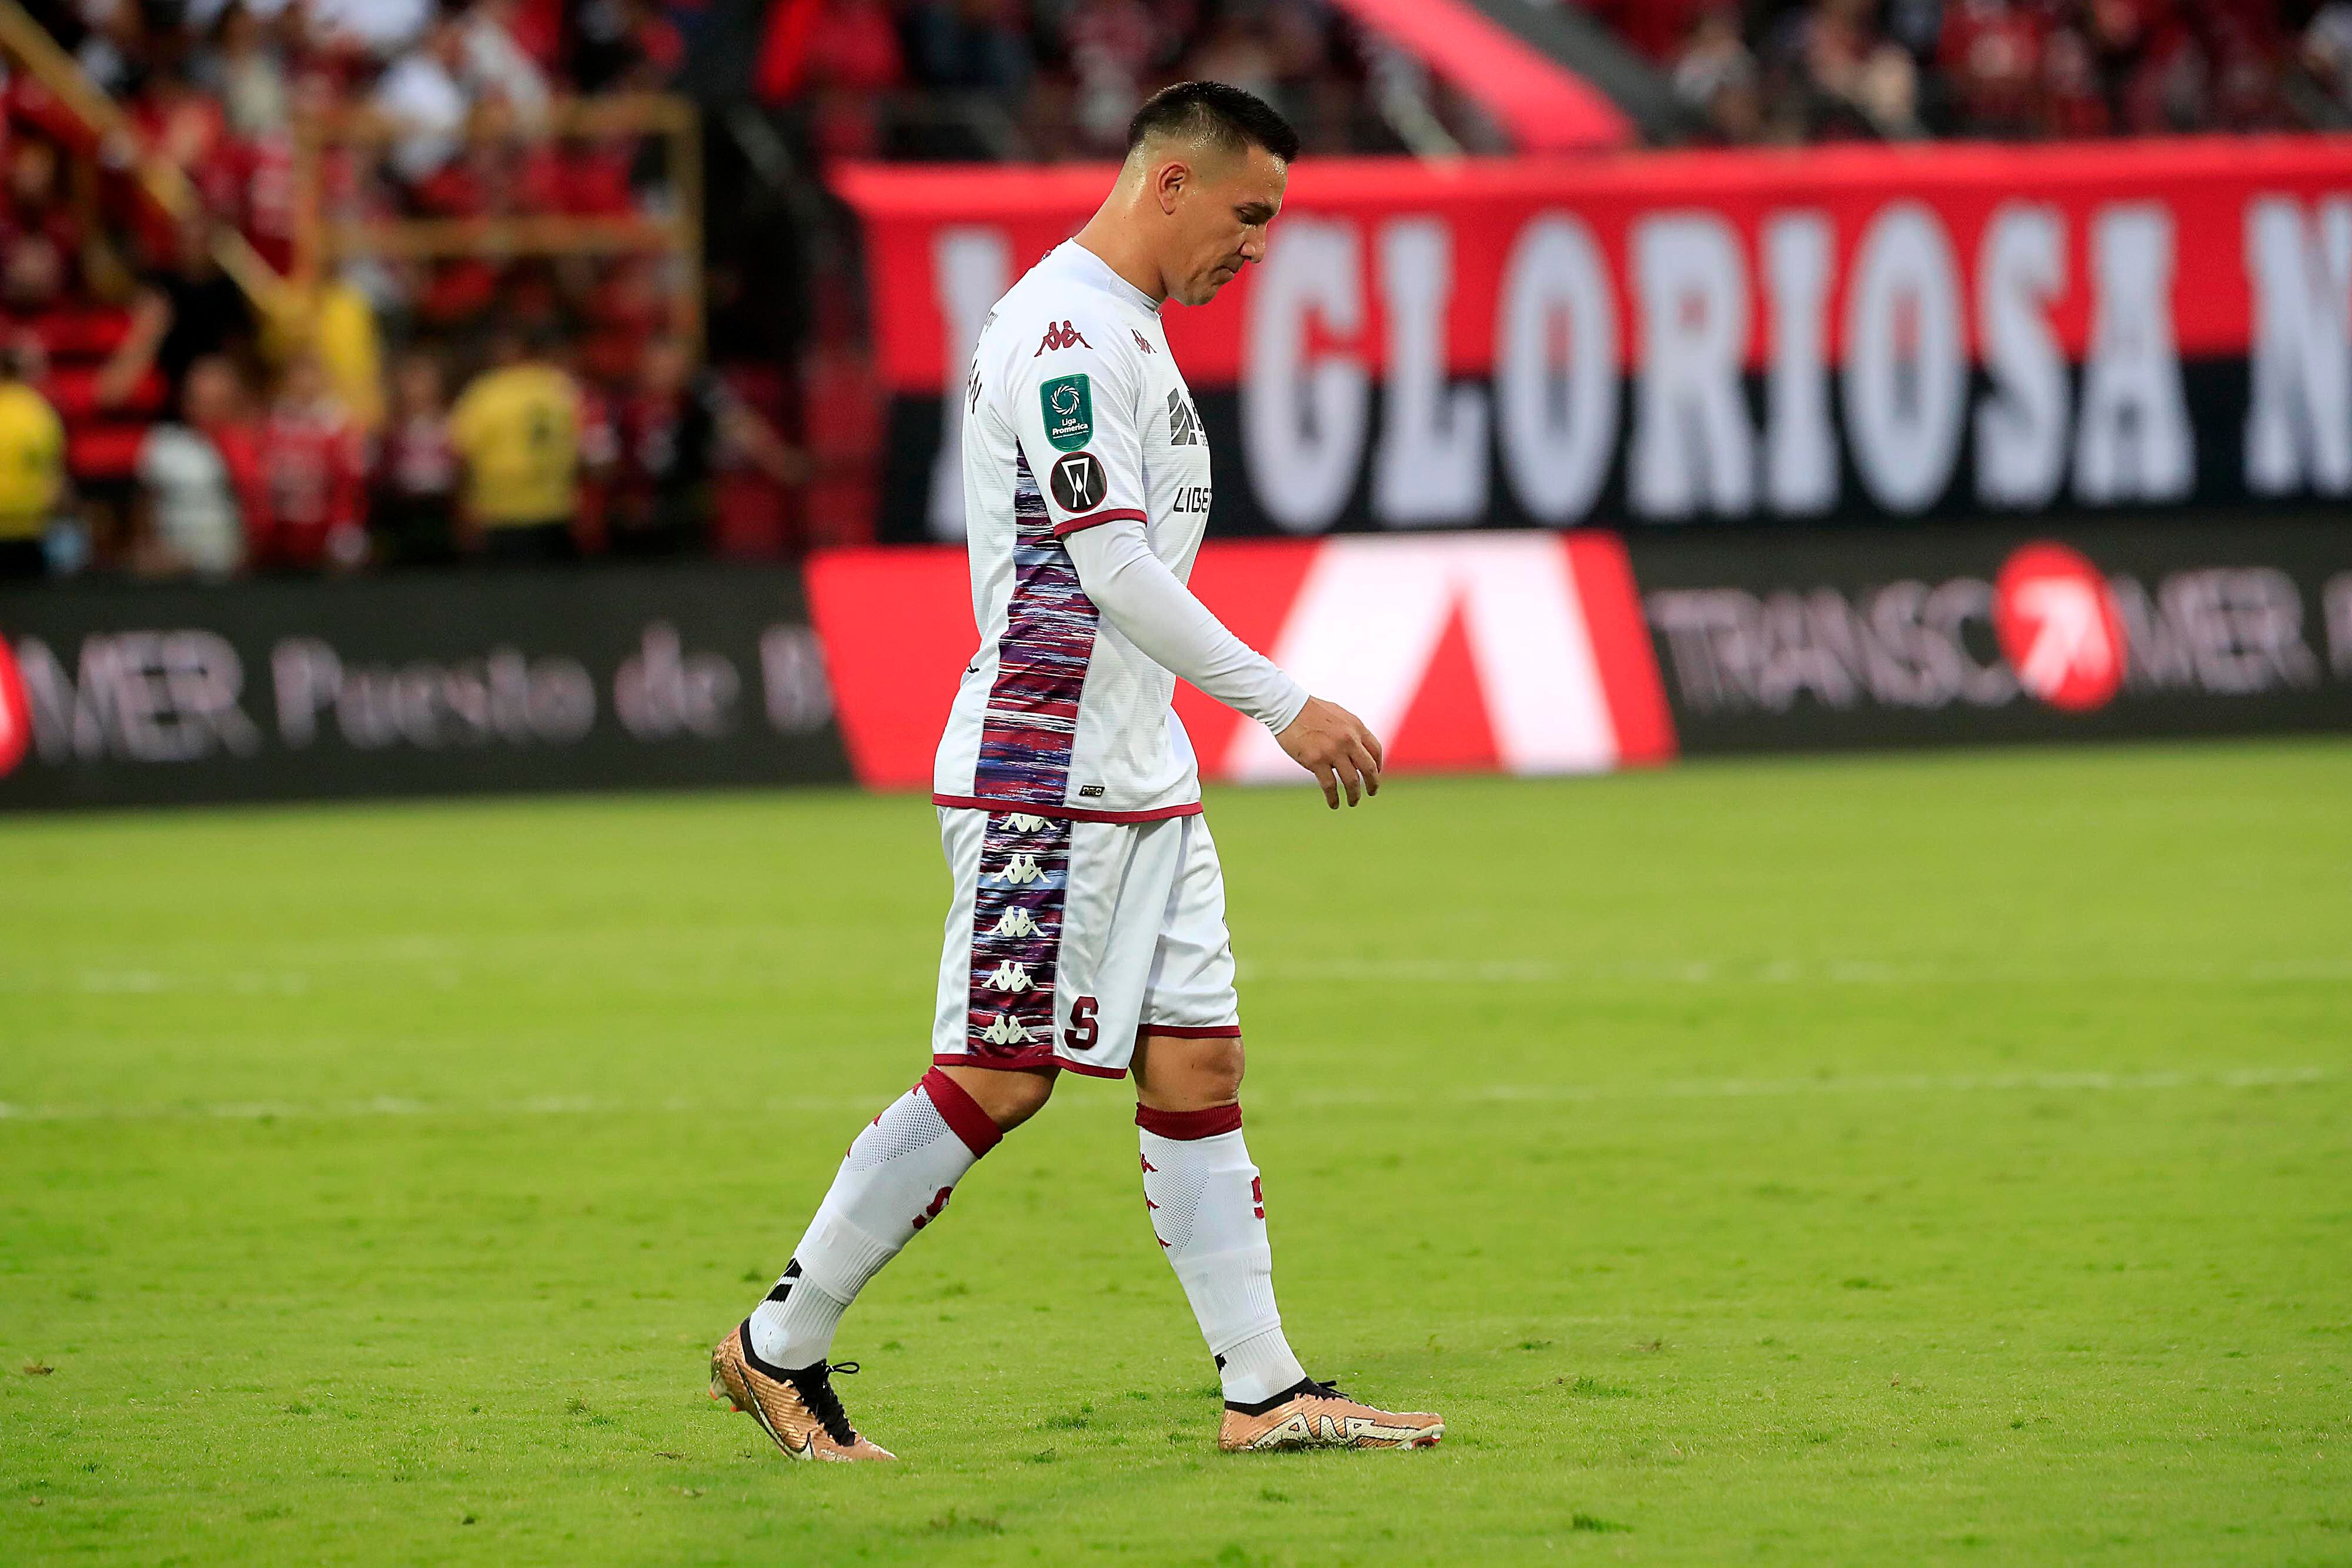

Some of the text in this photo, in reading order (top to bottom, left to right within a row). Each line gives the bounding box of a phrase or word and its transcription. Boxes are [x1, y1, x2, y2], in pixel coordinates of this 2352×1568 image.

[1240, 197, 2200, 534] GLORIOSA
[1052, 423, 1088, 436] Promerica
[1061, 418, 1077, 426] Liga
[269, 634, 597, 751] Puesto
[613, 616, 742, 741] de
[1064, 996, 1099, 1050] S
